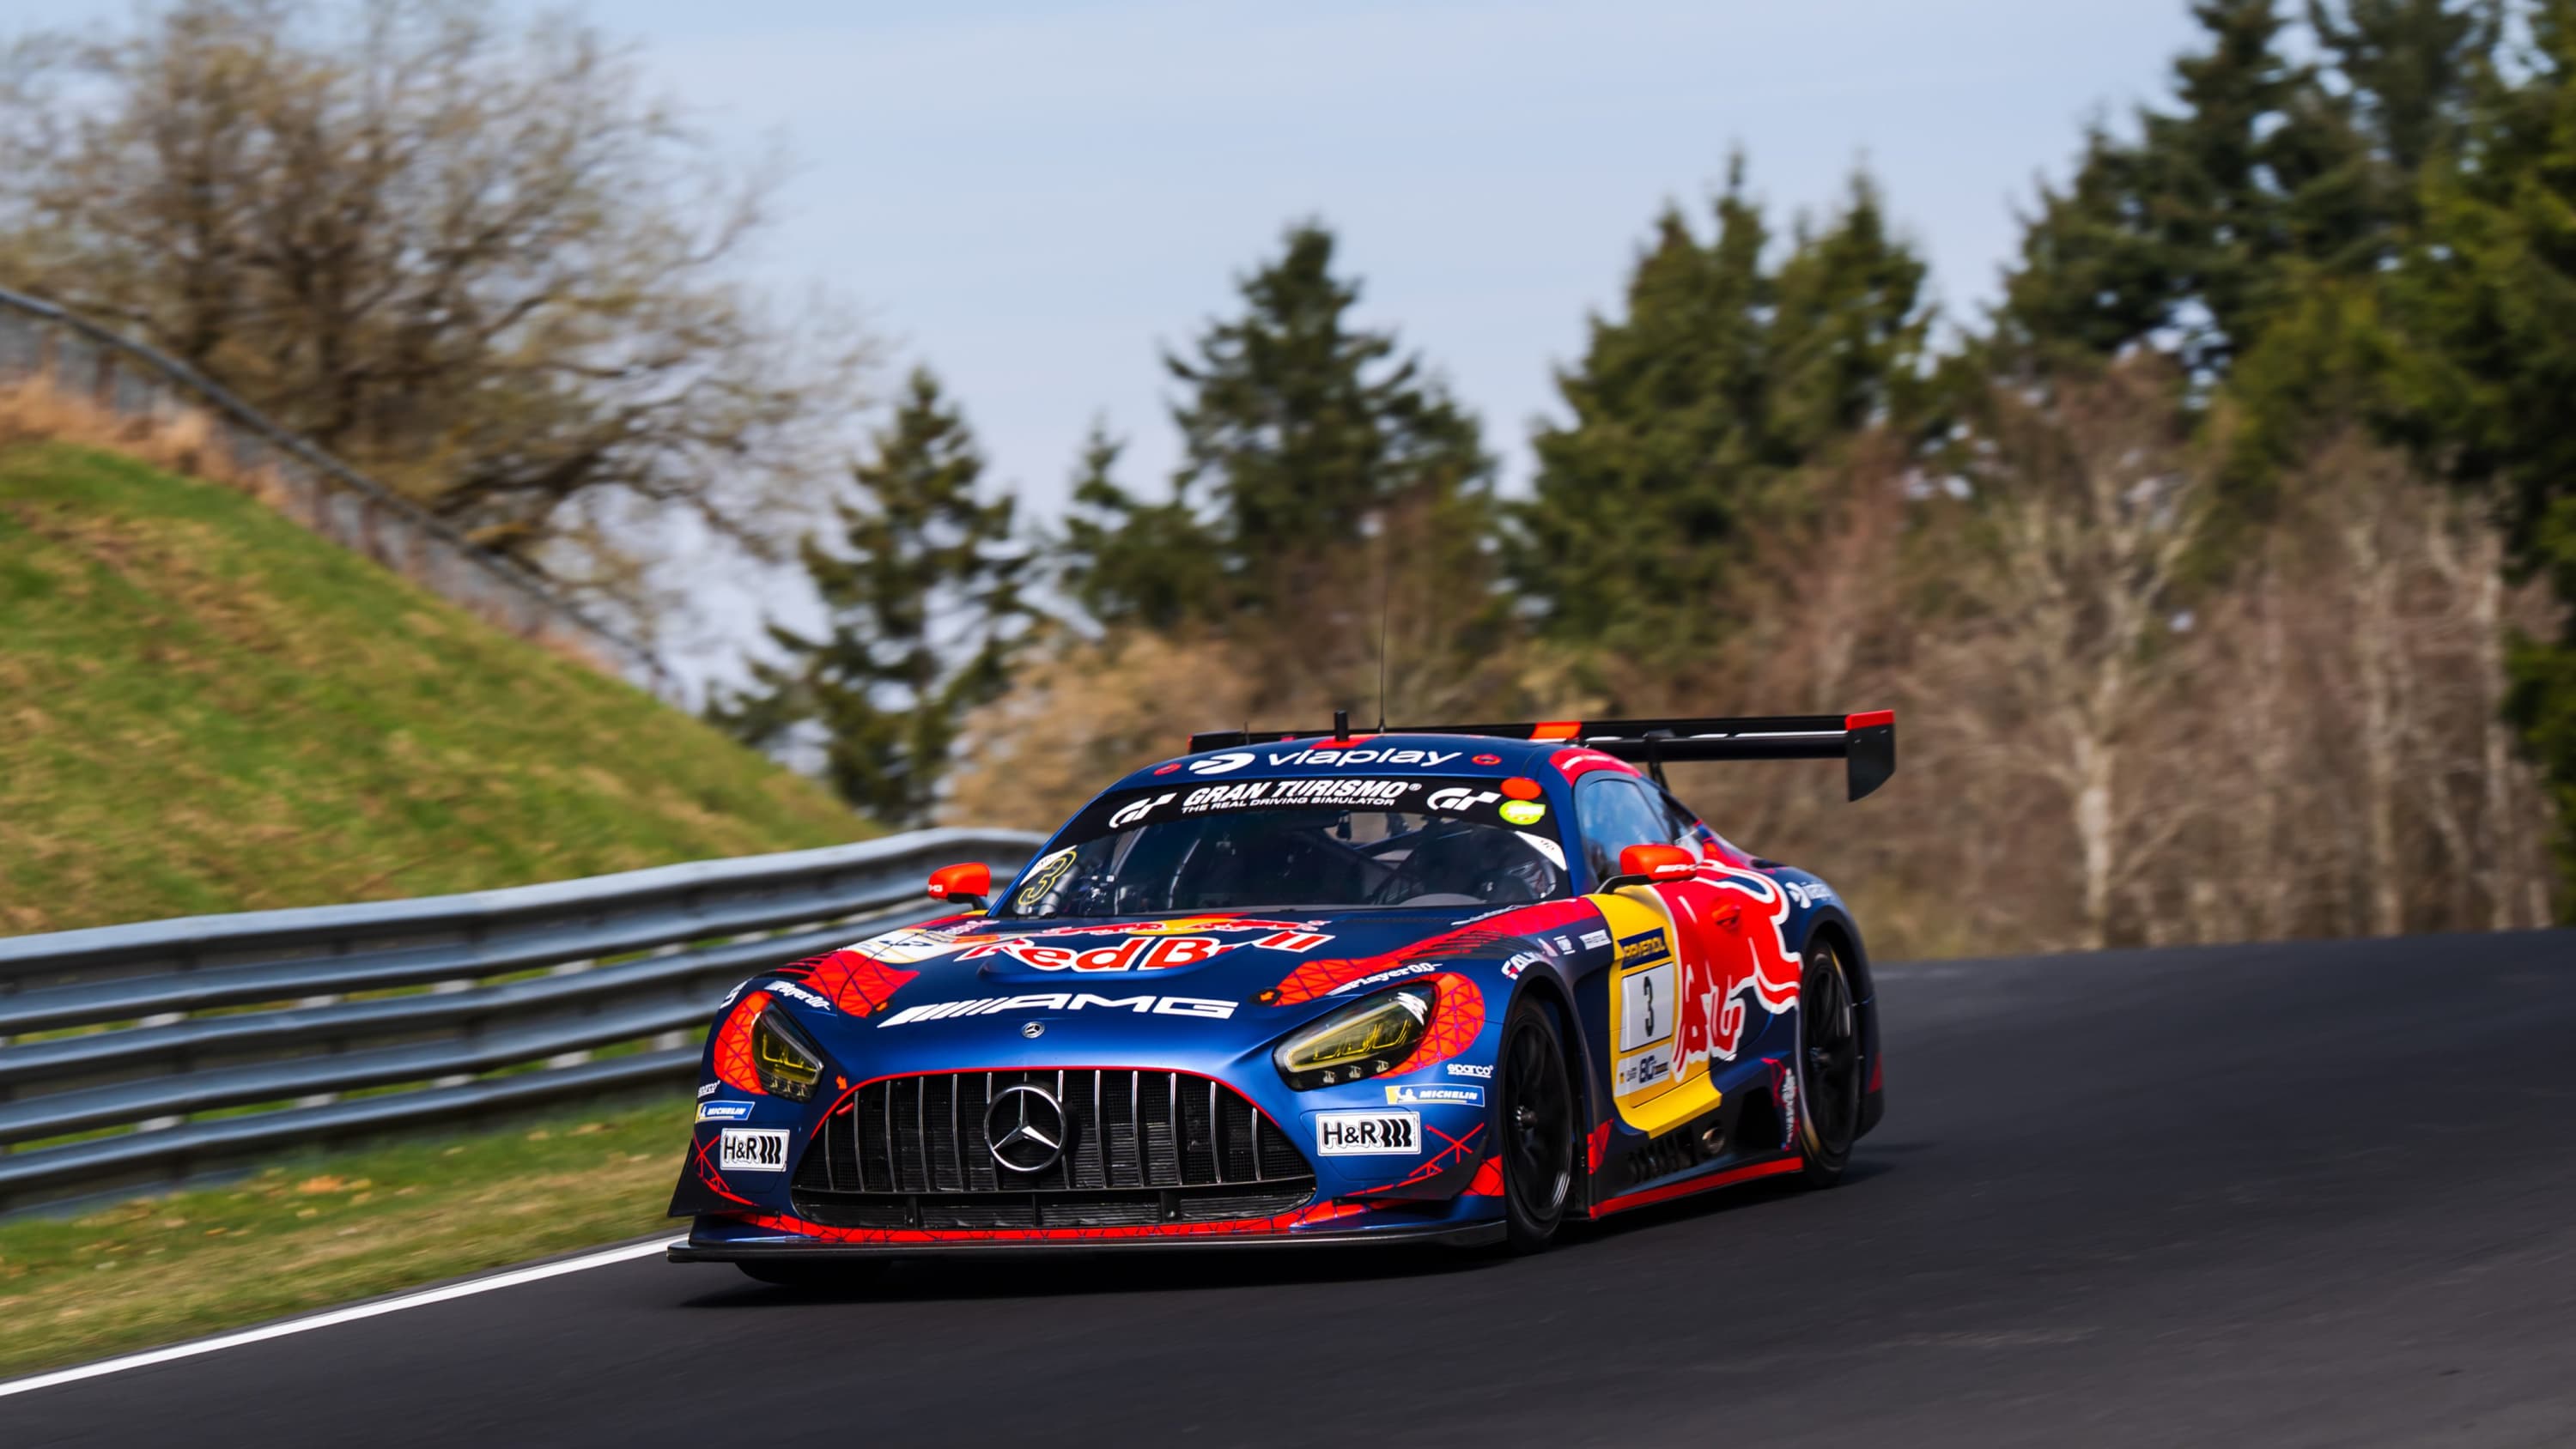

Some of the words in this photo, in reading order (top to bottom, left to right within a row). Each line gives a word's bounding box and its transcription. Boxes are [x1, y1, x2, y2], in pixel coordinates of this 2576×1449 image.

[1268, 748, 1462, 767] viaplay
[1182, 803, 1205, 814] THE
[1209, 800, 1248, 811] REAL
[1249, 797, 1308, 808] DRIVING
[1310, 797, 1396, 807] SIMULATOR
[1183, 782, 1272, 806] GRAN
[1018, 851, 1077, 906] 3
[981, 993, 1239, 1020] AMG
[1643, 975, 1654, 1037] 3
[1419, 1089, 1478, 1100] MICHELIN
[1323, 1121, 1377, 1145] H&R
[724, 1137, 757, 1160] H&R
